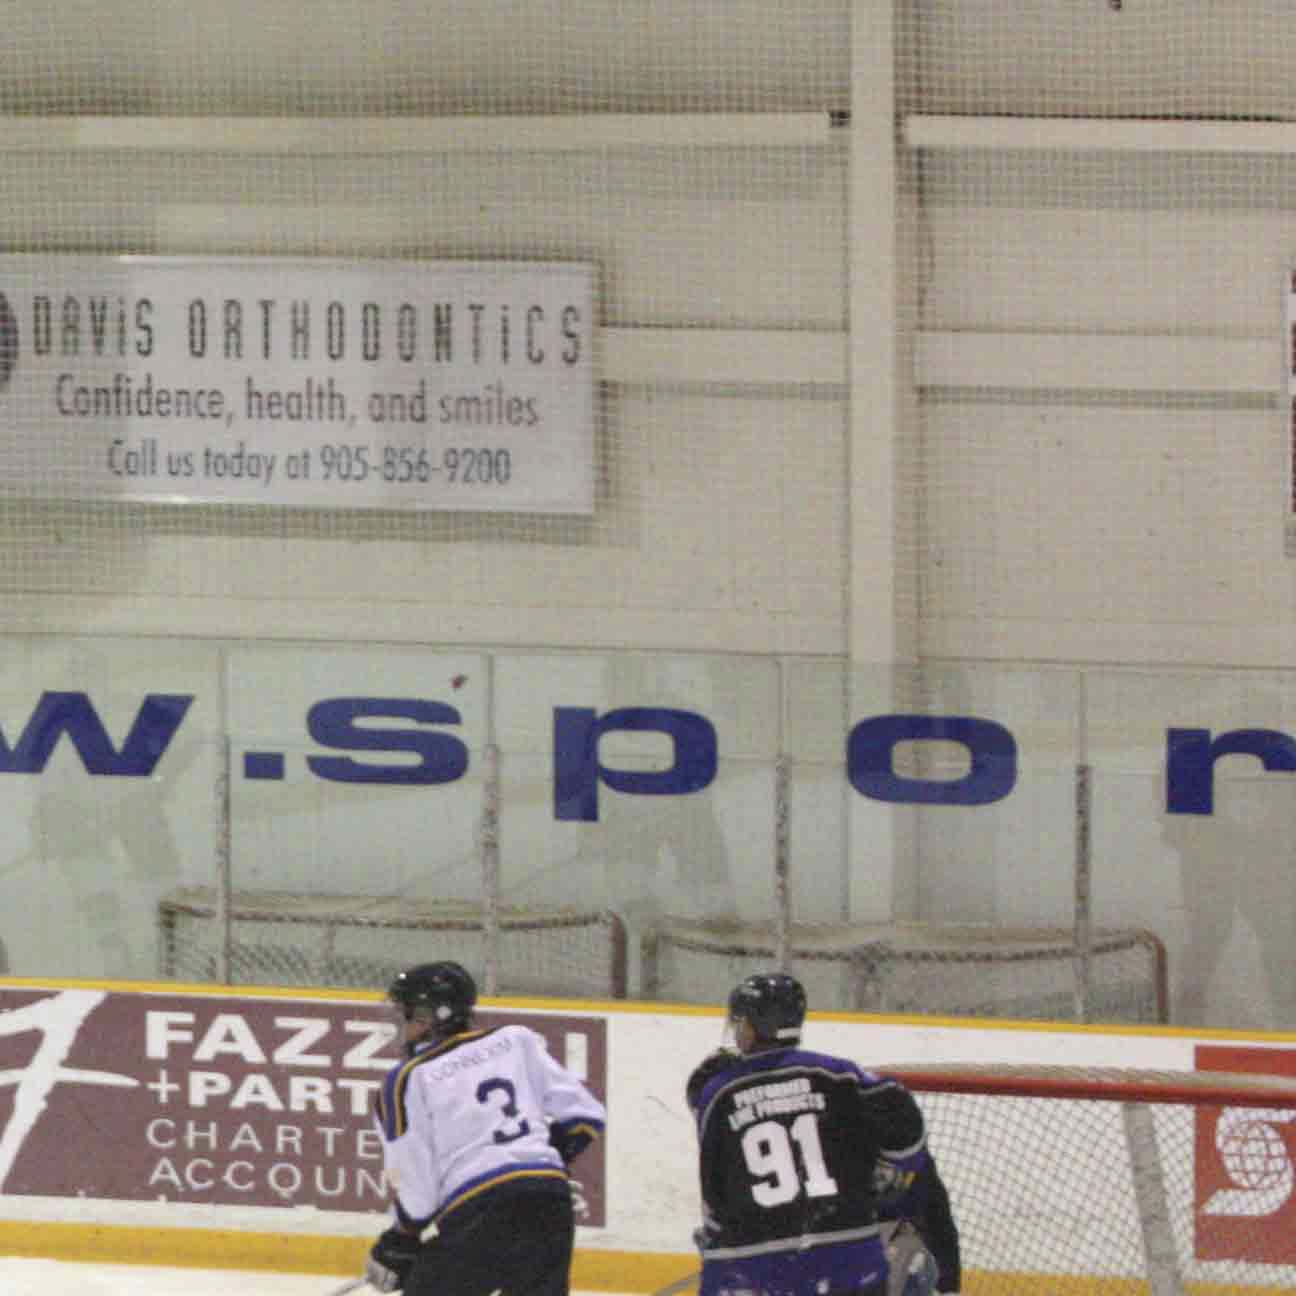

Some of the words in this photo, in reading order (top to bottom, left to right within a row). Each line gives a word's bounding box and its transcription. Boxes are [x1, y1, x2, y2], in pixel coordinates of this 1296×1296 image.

[56, 373, 234, 427] Confidence,
[246, 377, 357, 427] health,
[368, 379, 427, 422] and
[439, 380, 539, 427] smiles
[109, 439, 156, 476] Call
[168, 452, 194, 477] us
[205, 442, 275, 485] today
[286, 449, 311, 480] at
[320, 444, 512, 484] 905-856-9200
[476, 1077, 531, 1145] 3
[741, 1112, 839, 1209] 91
